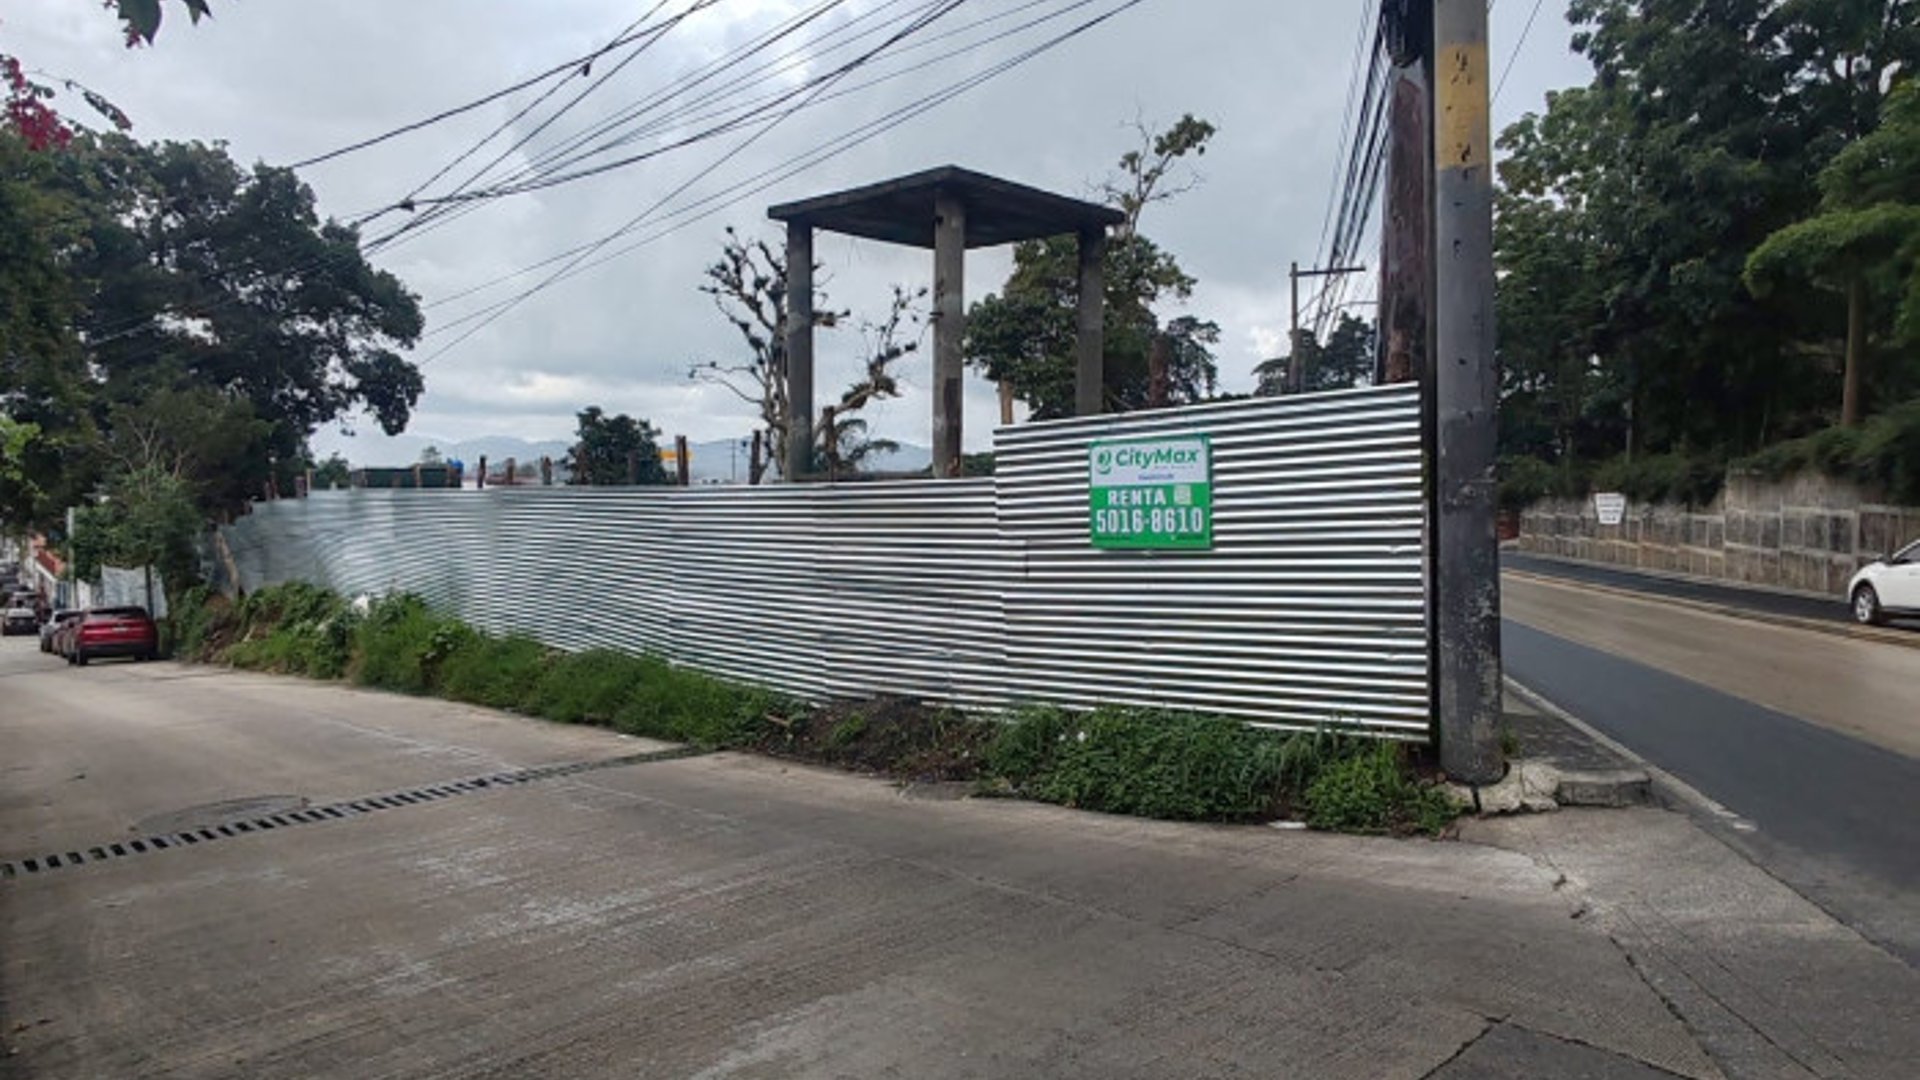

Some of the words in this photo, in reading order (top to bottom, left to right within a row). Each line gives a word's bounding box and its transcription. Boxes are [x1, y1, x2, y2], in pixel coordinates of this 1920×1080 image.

[1115, 447, 1198, 469] CityMax
[1107, 489, 1167, 506] RENTA
[1096, 507, 1203, 533] 5016-8610
